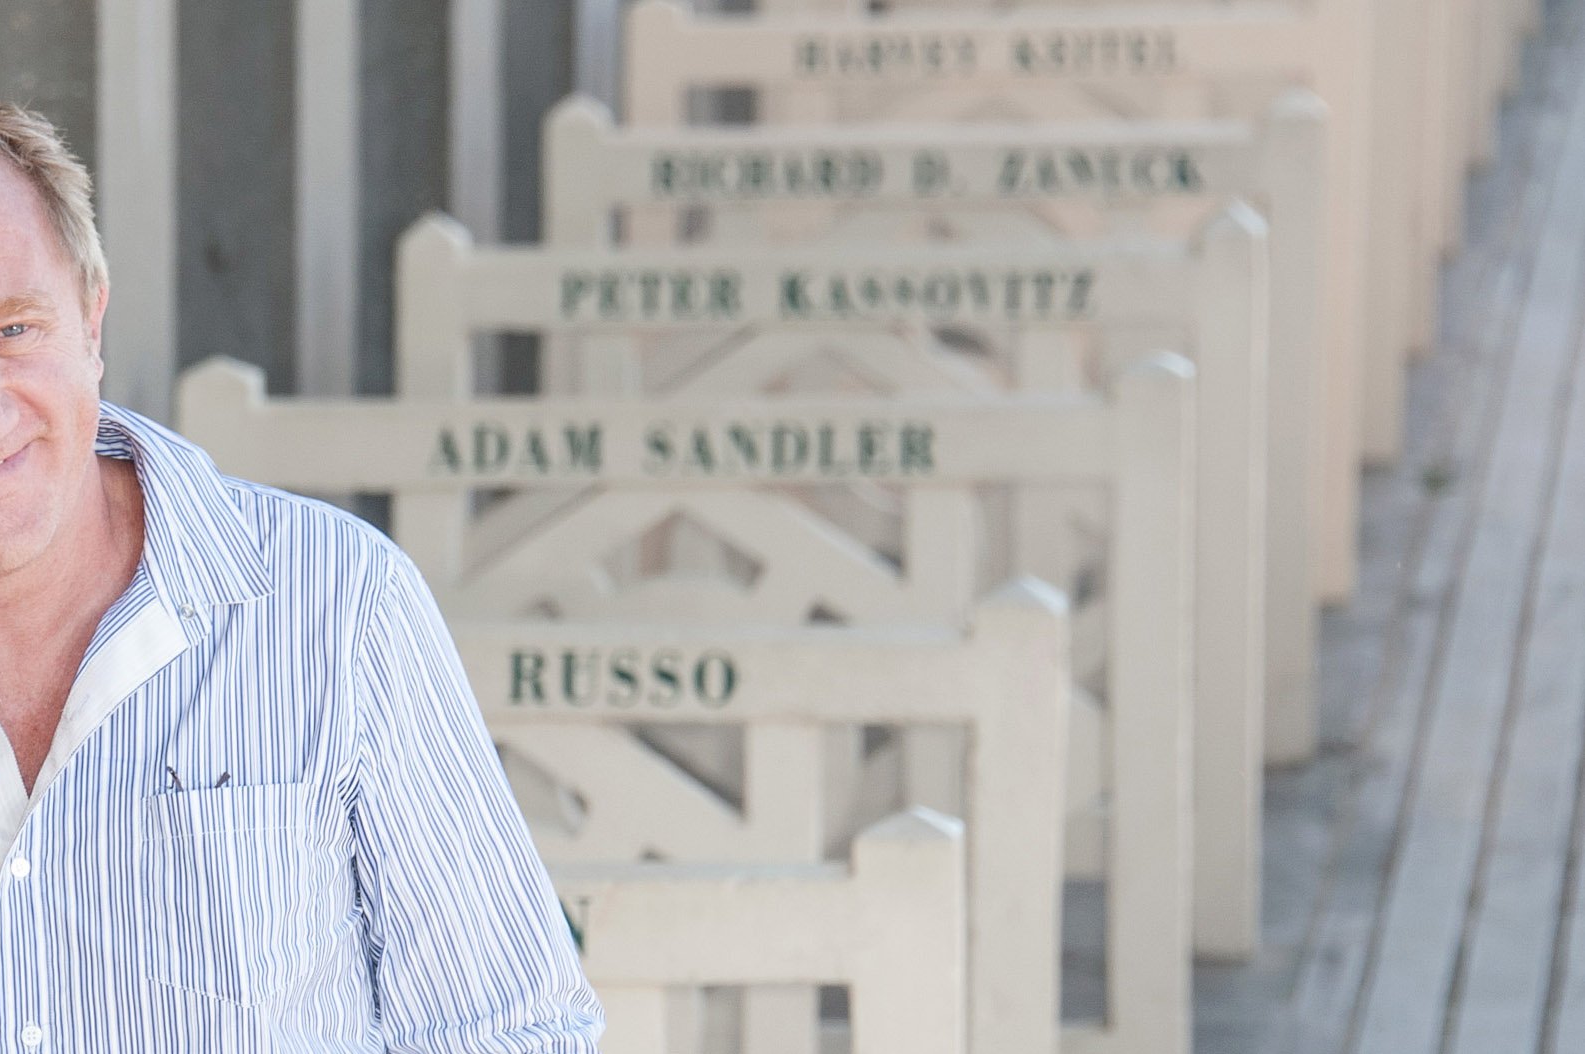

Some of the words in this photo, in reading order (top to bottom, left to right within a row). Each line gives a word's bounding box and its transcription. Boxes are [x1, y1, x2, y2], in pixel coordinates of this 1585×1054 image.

[651, 151, 884, 197] RICHARD
[559, 270, 742, 319] PETER
[776, 269, 1096, 319] KASSOVITZ
[431, 424, 604, 474] ADAM
[644, 422, 937, 474] SANDLER
[508, 649, 739, 706] RUSSO
